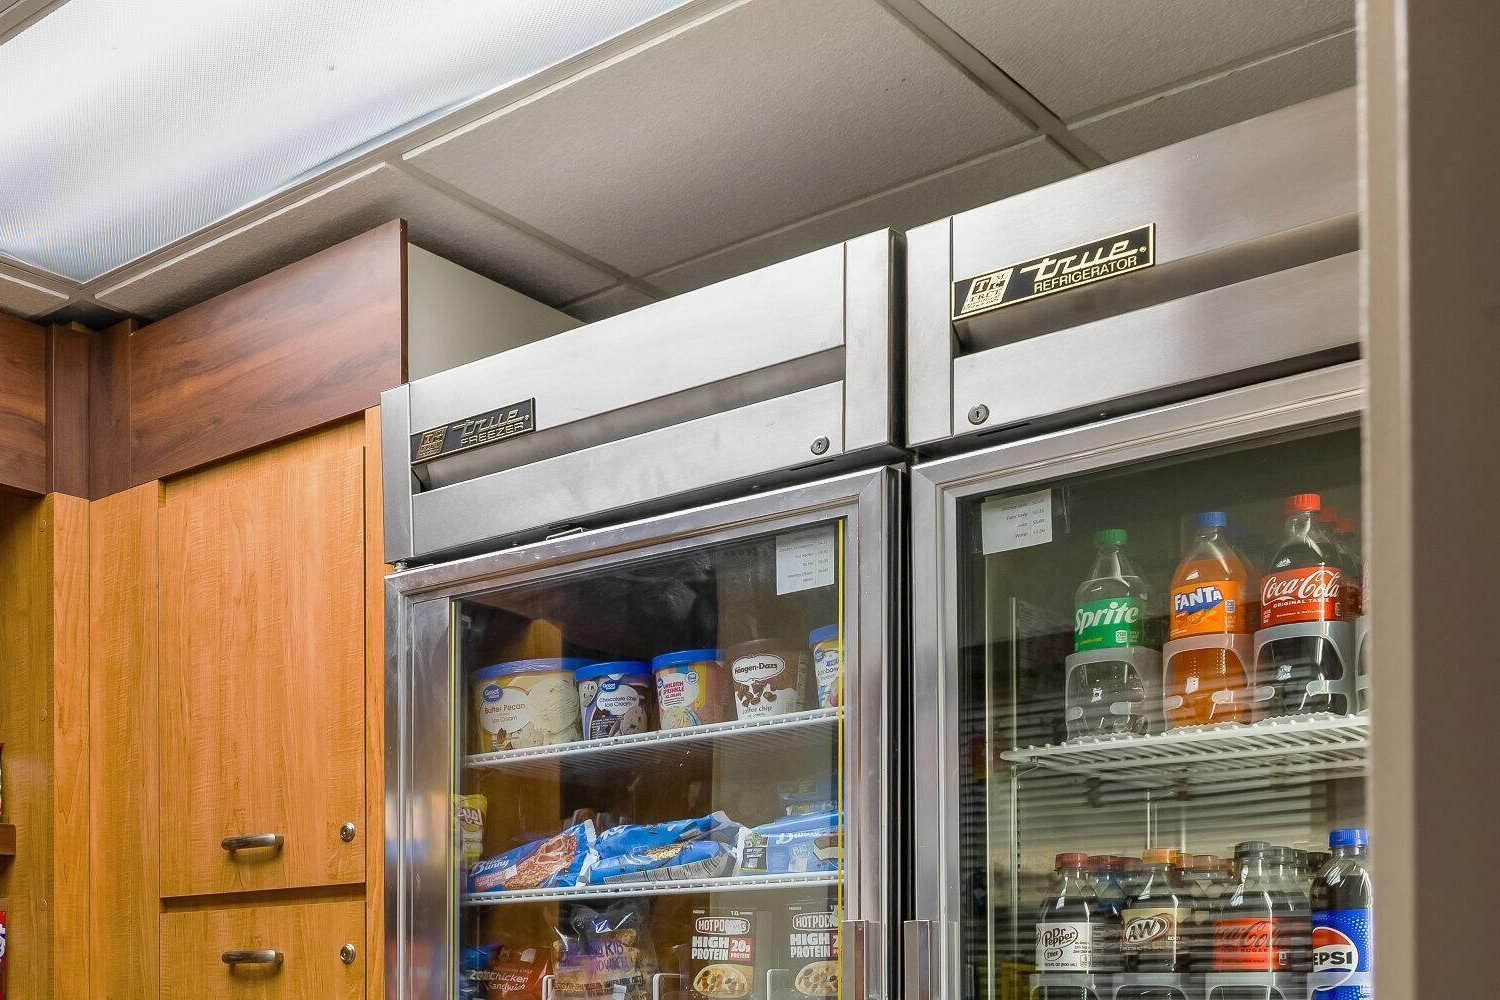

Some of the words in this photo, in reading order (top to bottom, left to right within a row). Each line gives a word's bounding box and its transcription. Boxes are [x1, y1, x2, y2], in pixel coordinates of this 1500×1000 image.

[1033, 256, 1137, 294] REFRIGERATOR
[460, 422, 524, 447] FREEZER
[1261, 569, 1341, 606] Coca-Cola
[1174, 585, 1223, 611] FANTA
[1273, 599, 1307, 609] ORIGINAL
[1074, 601, 1140, 635] Sprite
[484, 705, 502, 715] Butter
[503, 703, 526, 712] Pecan
[758, 704, 773, 712] chip
[500, 715, 518, 723] Cream
[698, 920, 713, 932] HOT
[795, 916, 810, 928] HOT
[1052, 928, 1067, 939] Dr
[1127, 917, 1161, 942] A&W
[692, 935, 730, 948] HIGH
[789, 932, 830, 946] HIGH
[1044, 931, 1076, 947] Pepper
[605, 940, 624, 956] RIB
[731, 940, 751, 952] 20g
[790, 945, 831, 958] PROTEIN
[692, 949, 729, 961] PROTEIN
[489, 971, 529, 983] Chicken
